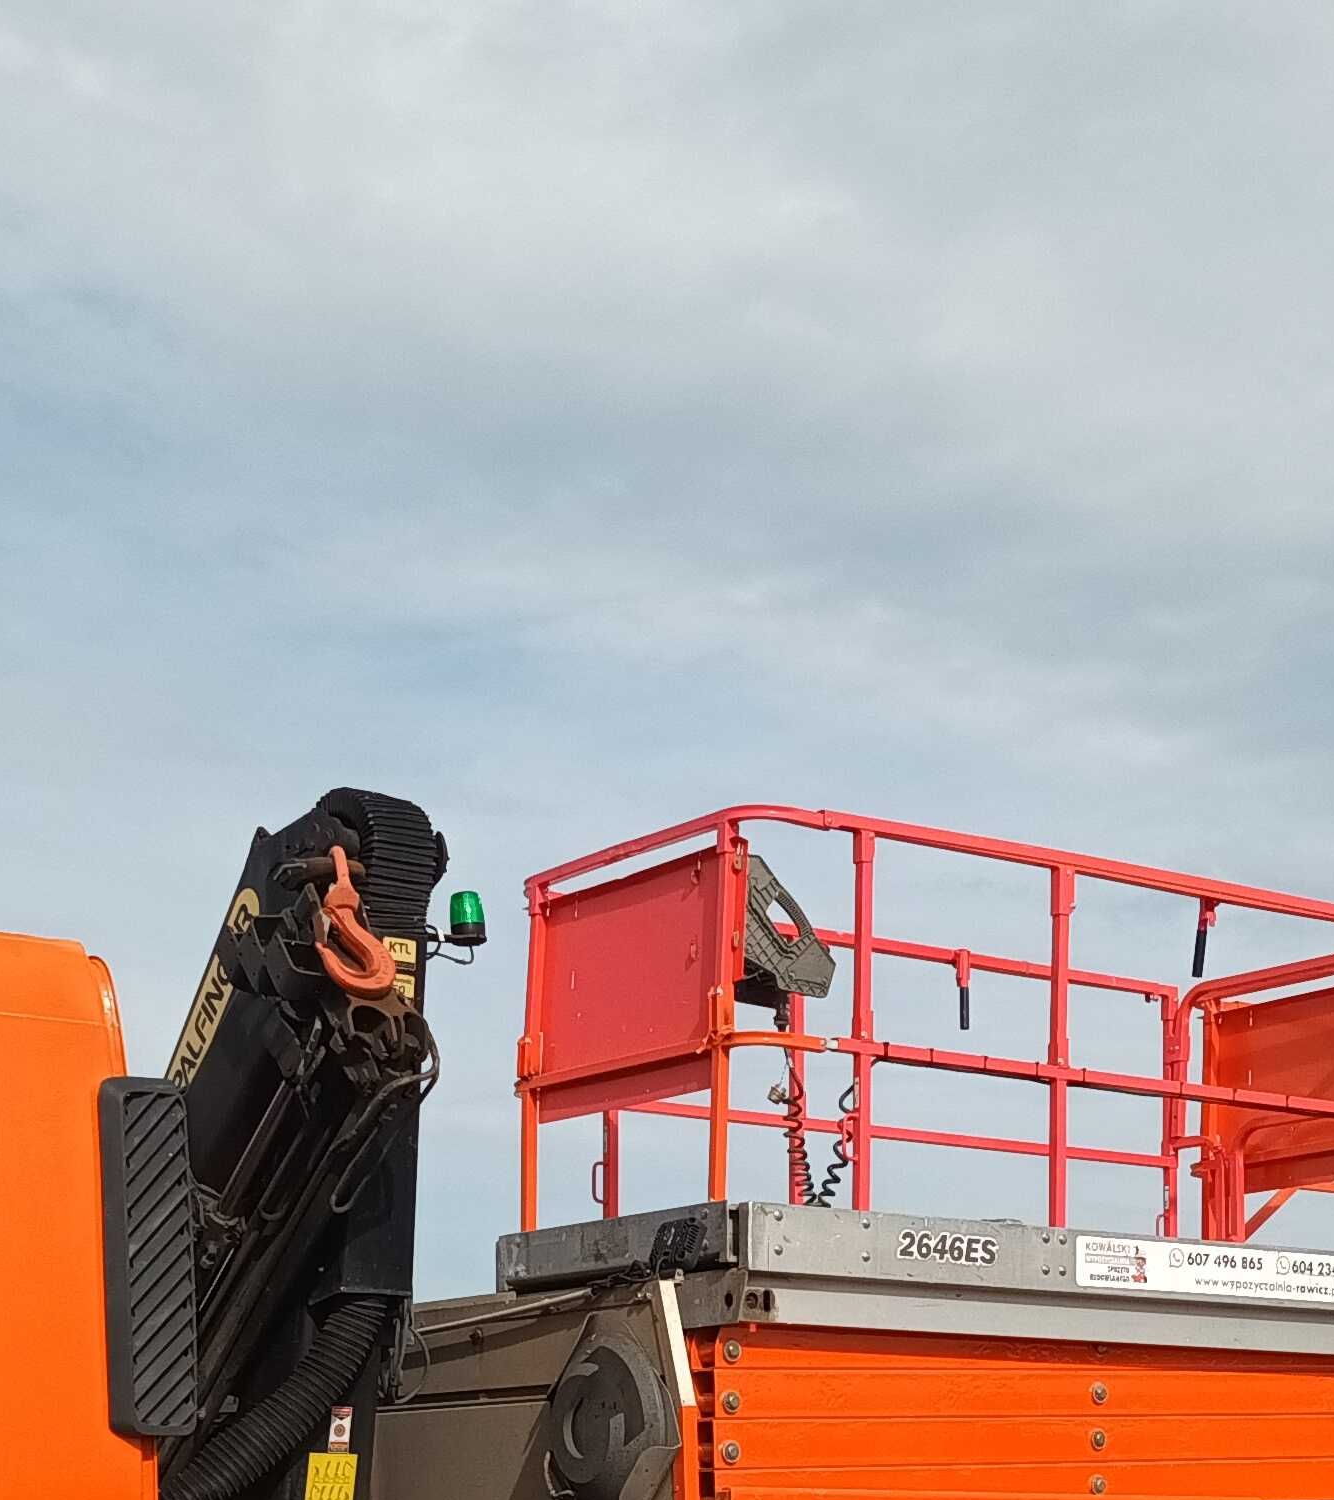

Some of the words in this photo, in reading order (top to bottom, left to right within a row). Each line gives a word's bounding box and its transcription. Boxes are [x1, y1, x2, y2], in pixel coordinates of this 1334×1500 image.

[388, 941, 412, 955] KTL
[172, 902, 252, 1089] PALFINGR
[898, 1229, 999, 1266] 2646ES
[1187, 1253, 1209, 1266] 607
[1214, 1255, 1237, 1269] 496
[1241, 1257, 1263, 1271] 865
[1292, 1261, 1313, 1274] 604
